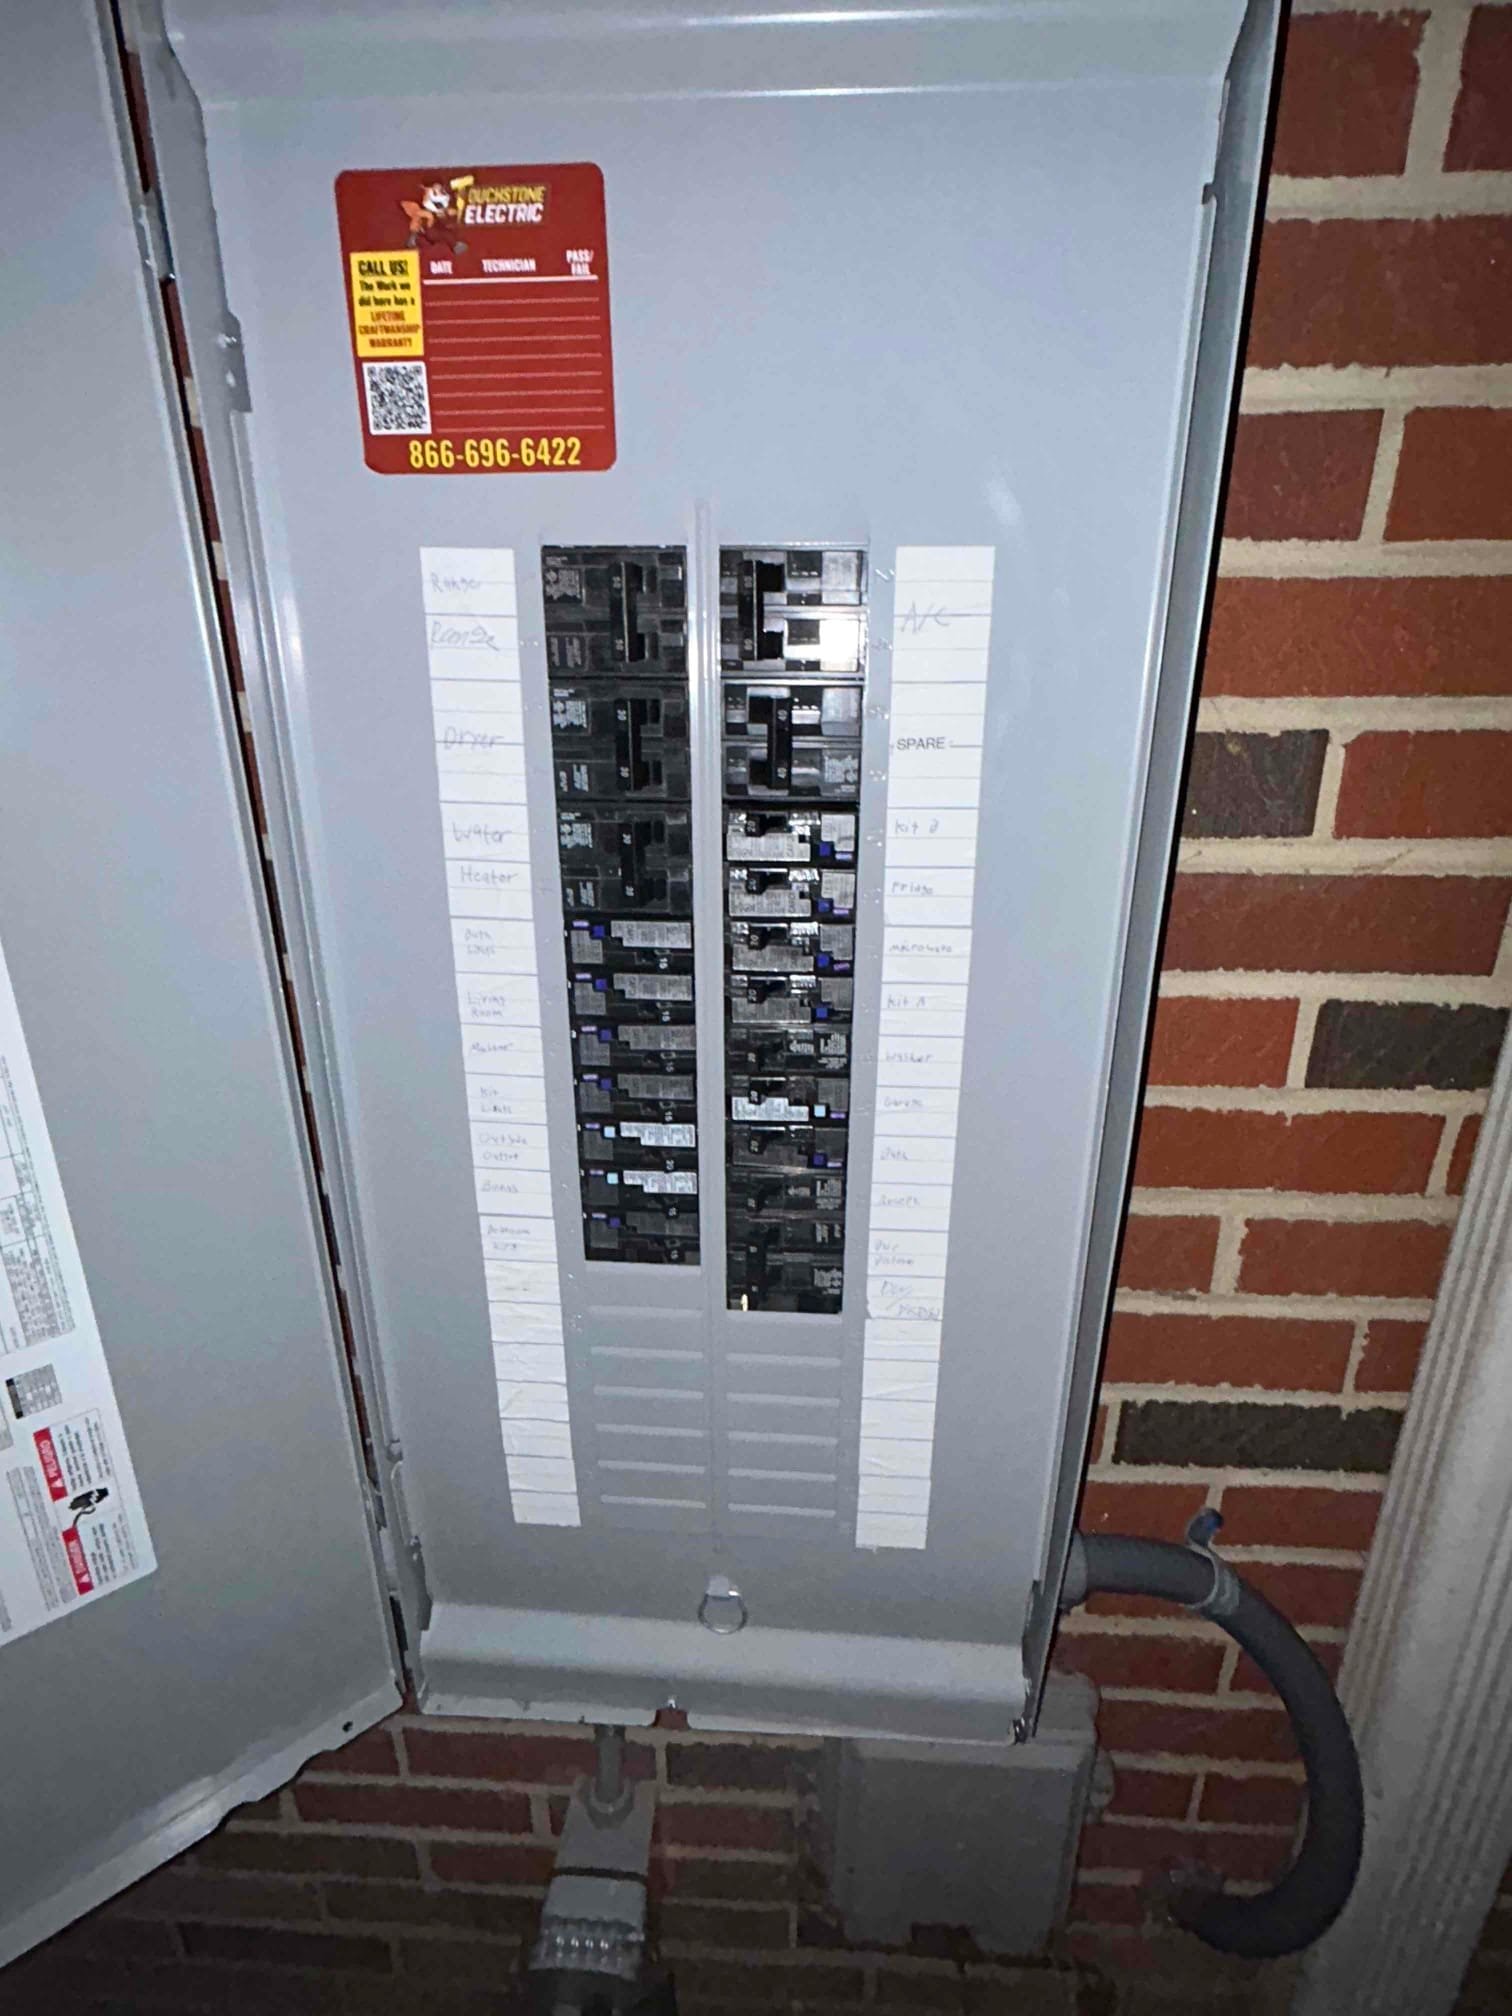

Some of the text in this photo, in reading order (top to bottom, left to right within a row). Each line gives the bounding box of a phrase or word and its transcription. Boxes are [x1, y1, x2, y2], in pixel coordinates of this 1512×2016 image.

[465, 202, 544, 225] ELECTRIC
[566, 249, 594, 263] PASS/
[358, 260, 409, 277] CALL US!
[430, 258, 536, 275] DATE TECHNICIAN
[571, 262, 591, 276] FAIL
[359, 280, 374, 291] The
[371, 310, 405, 322] LIFETIME
[369, 337, 412, 348] WARRANTY
[408, 436, 582, 469] 866-696-6422
[901, 599, 951, 635] A/C
[896, 736, 946, 751] SPARE
